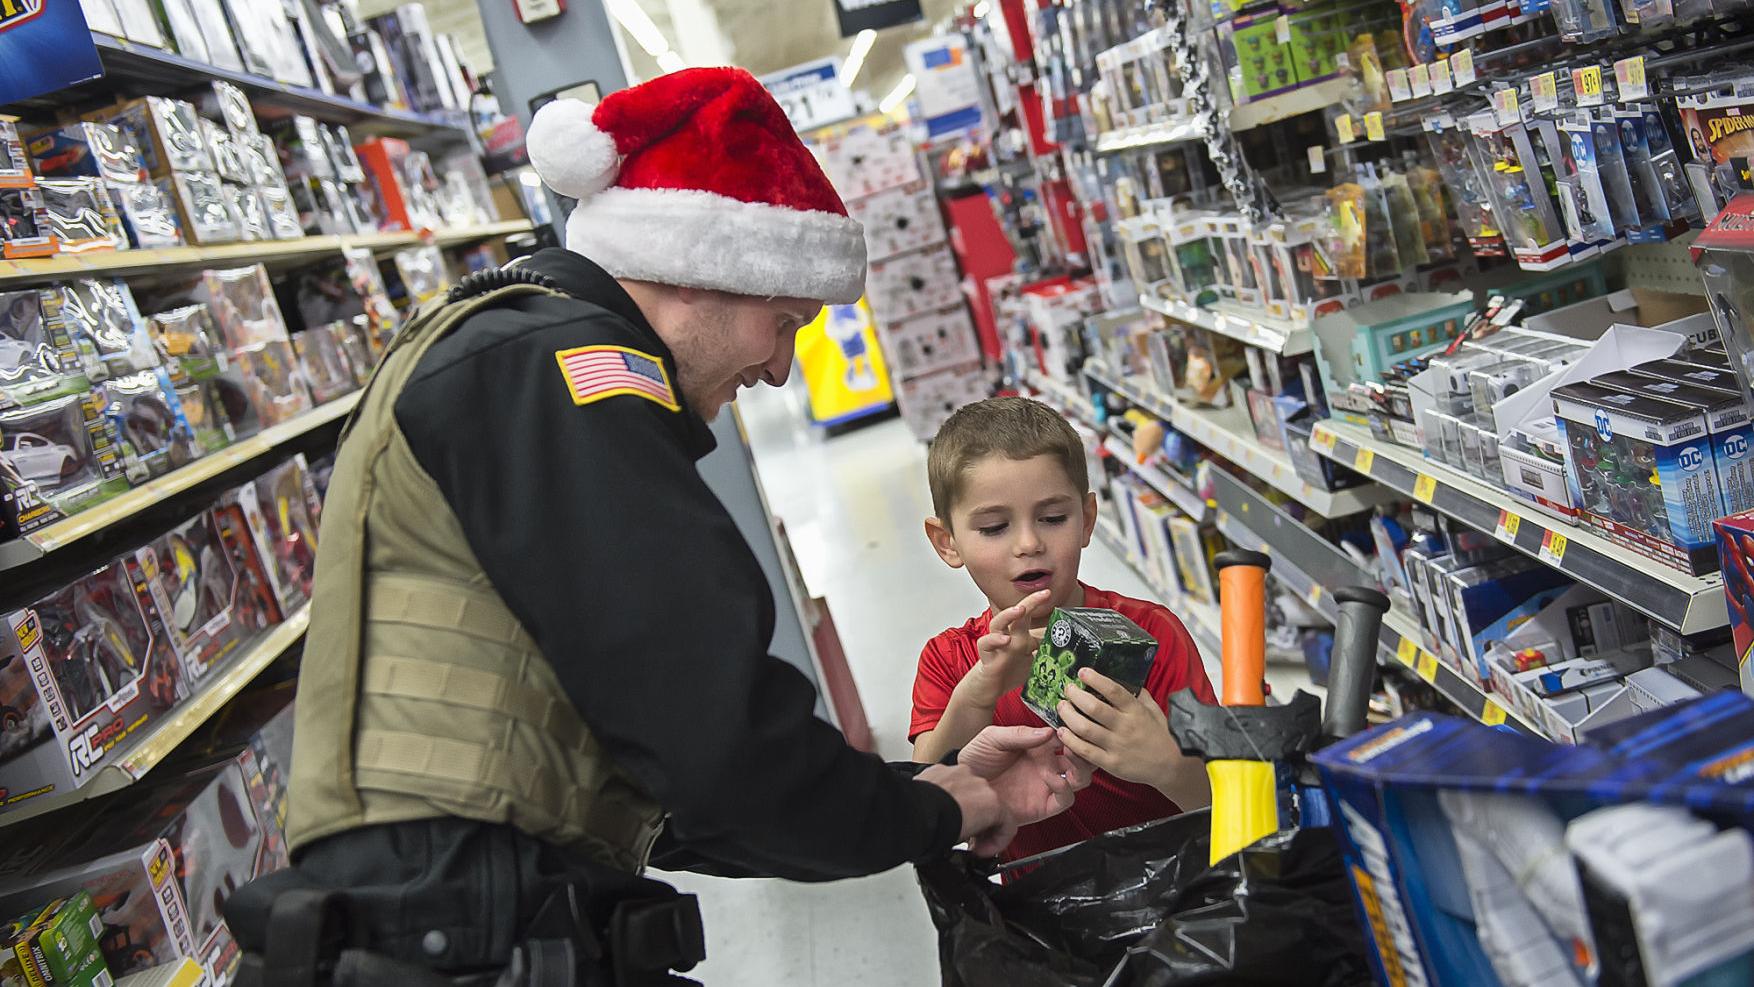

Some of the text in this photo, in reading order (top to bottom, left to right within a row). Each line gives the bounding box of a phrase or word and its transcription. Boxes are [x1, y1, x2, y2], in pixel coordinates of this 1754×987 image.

[1594, 414, 1613, 438] DC
[1724, 437, 1748, 456] DC
[1679, 450, 1703, 469] DC
[69, 722, 105, 777] RC
